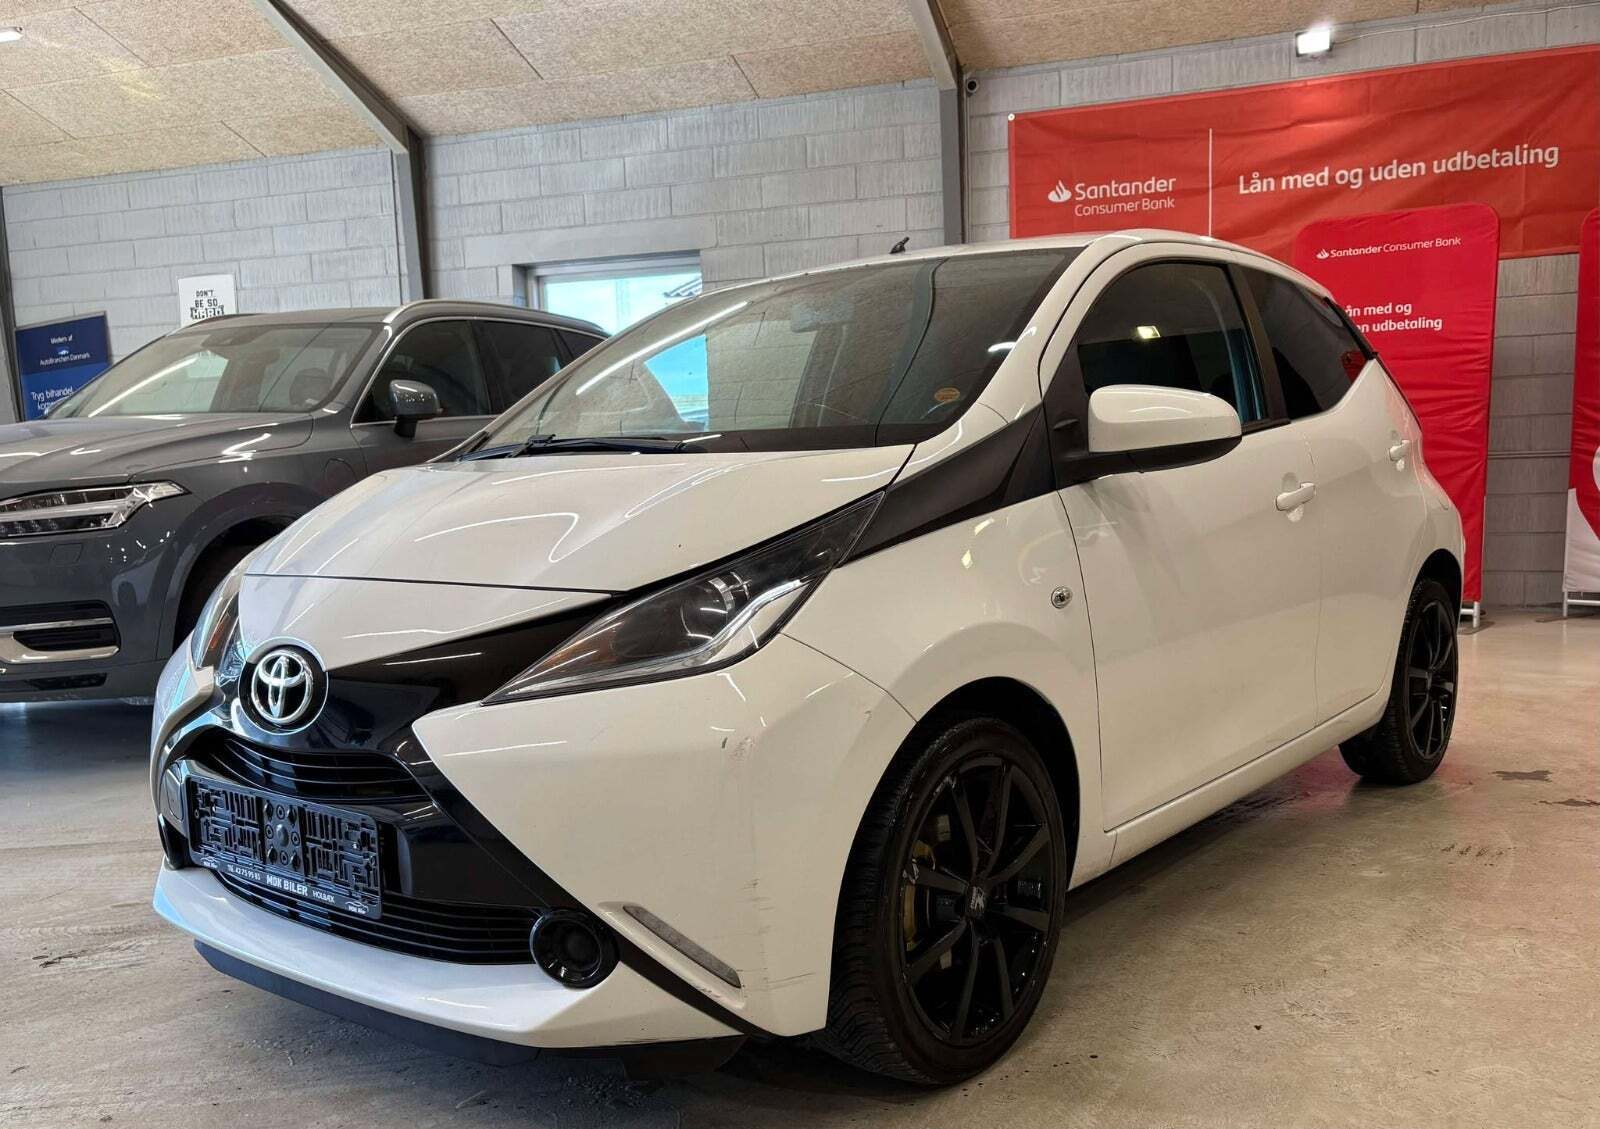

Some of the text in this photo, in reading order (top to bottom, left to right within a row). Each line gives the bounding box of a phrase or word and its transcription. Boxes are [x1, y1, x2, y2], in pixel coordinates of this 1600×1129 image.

[1239, 143, 1560, 194] Lån med og uden udbetaling
[1075, 176, 1177, 200] Santander
[1075, 196, 1175, 217] Consumer Bank
[1330, 236, 1461, 258] Santander Consumer Bank
[194, 298, 218, 308] BE SO
[1345, 302, 1412, 317] ån med og
[1372, 316, 1442, 332] udbetaling
[31, 391, 45, 402] Tryg
[284, 880, 308, 897] BILER
